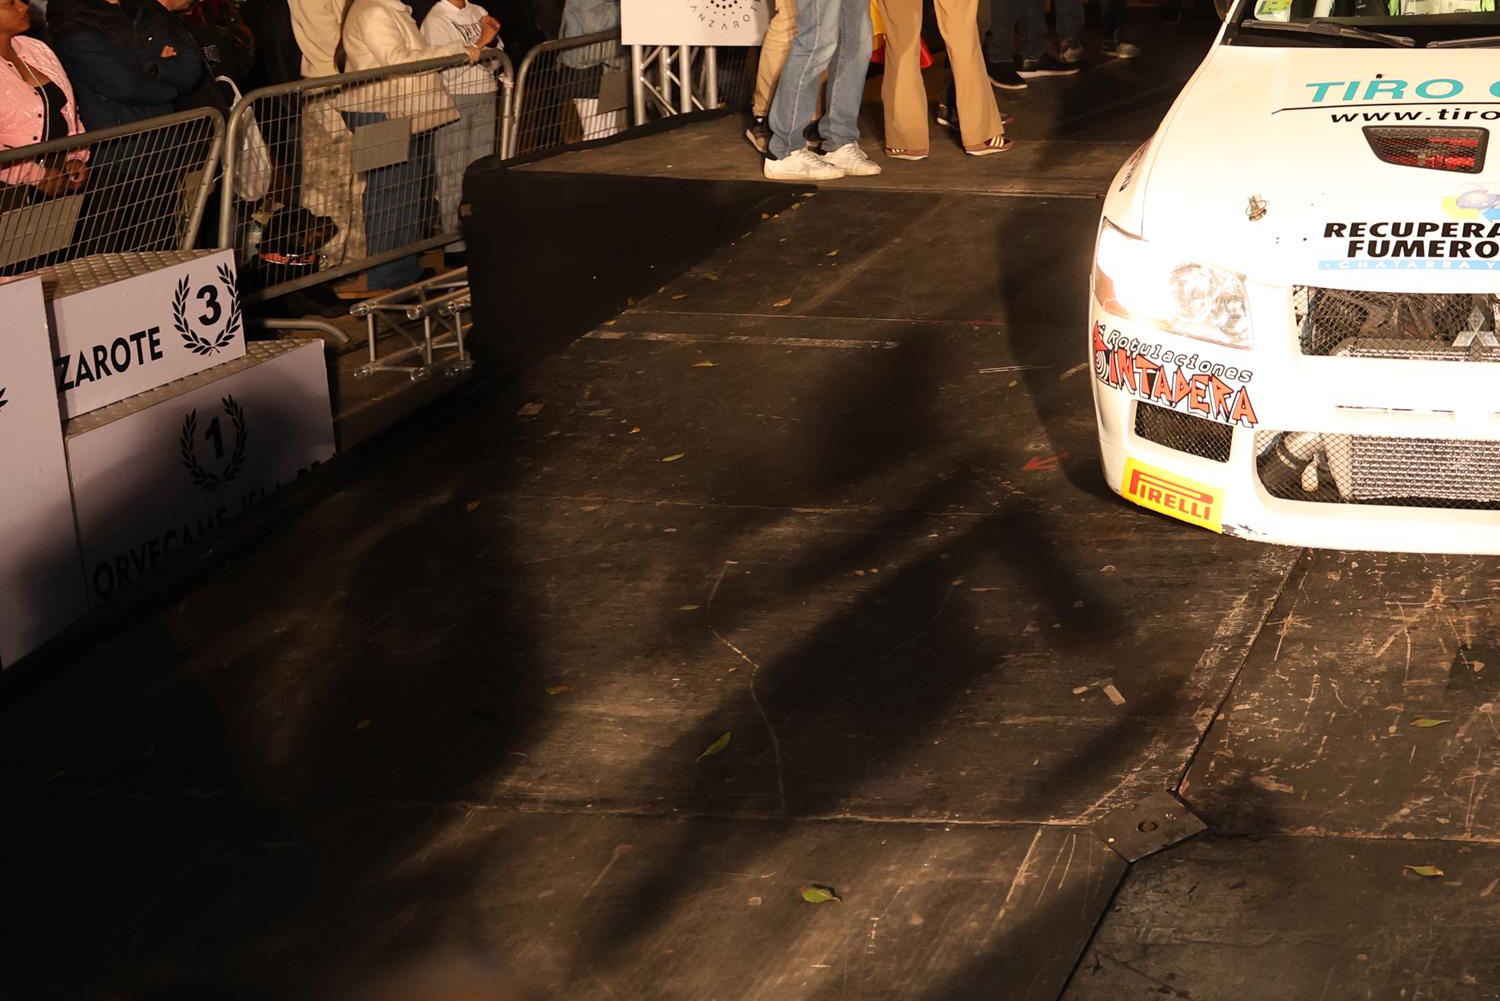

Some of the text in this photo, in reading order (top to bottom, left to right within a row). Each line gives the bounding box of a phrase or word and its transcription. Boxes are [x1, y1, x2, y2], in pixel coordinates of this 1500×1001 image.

[1305, 79, 1464, 103] TIRO
[1338, 259, 1470, 270] CHATARRA
[1486, 261, 1497, 270] Y
[1346, 239, 1500, 259] FUMERO
[198, 284, 222, 326] 3
[54, 326, 164, 393] ZAROTE
[1107, 329, 1253, 383] Rotulaciones
[204, 417, 224, 459] 1
[1128, 469, 1215, 521] PIRELLI
